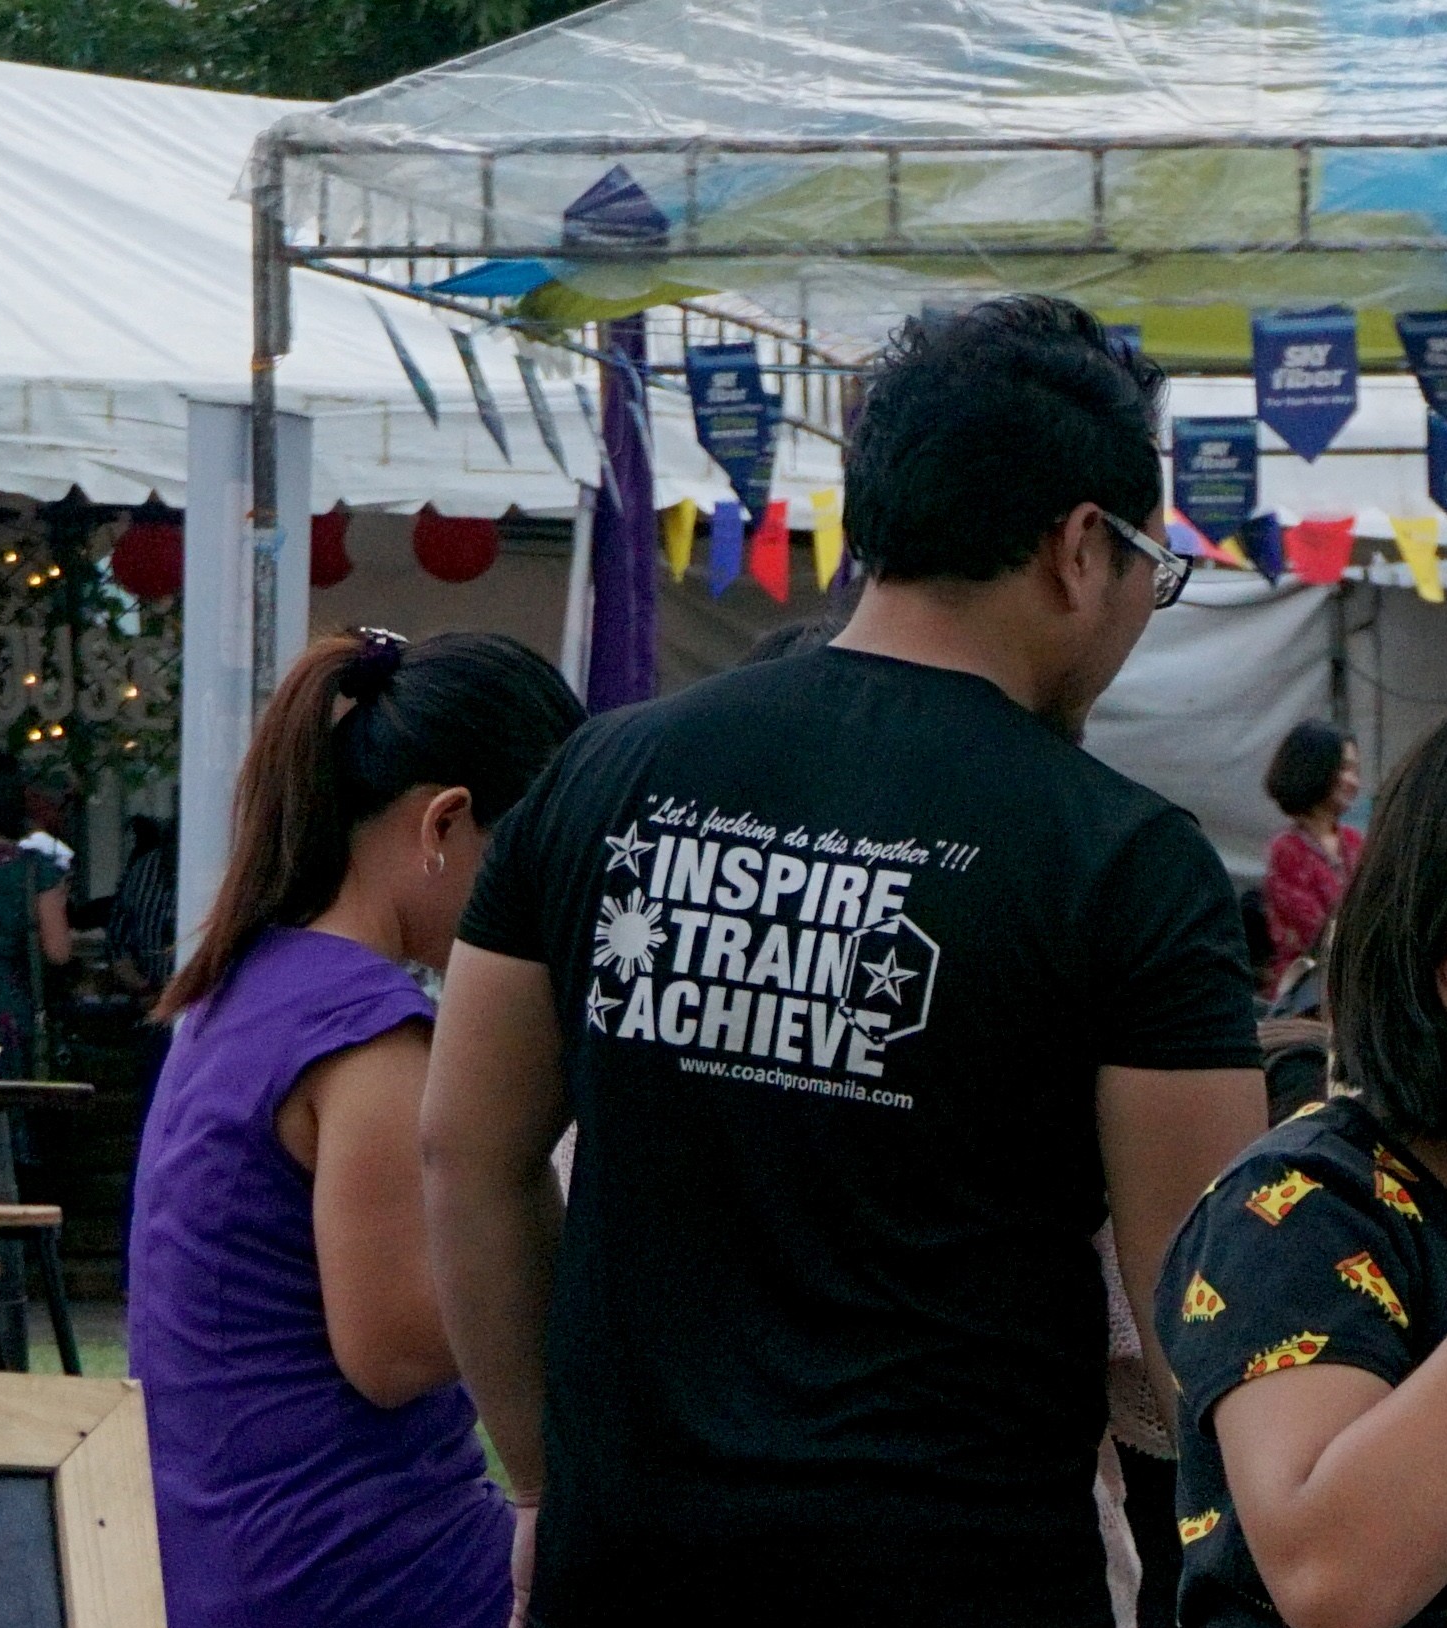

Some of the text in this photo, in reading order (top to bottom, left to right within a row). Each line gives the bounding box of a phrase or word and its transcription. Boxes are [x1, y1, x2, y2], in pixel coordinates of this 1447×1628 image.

[1282, 344, 1332, 368] SKY
[699, 806, 777, 850] fucking
[783, 825, 809, 849] do
[813, 828, 849, 855] this
[650, 834, 912, 935] INSPIRE
[670, 908, 859, 998] TRAIN
[617, 976, 892, 1078] ACHIEVE
[679, 1056, 914, 1110] www.coachpromanila.com
